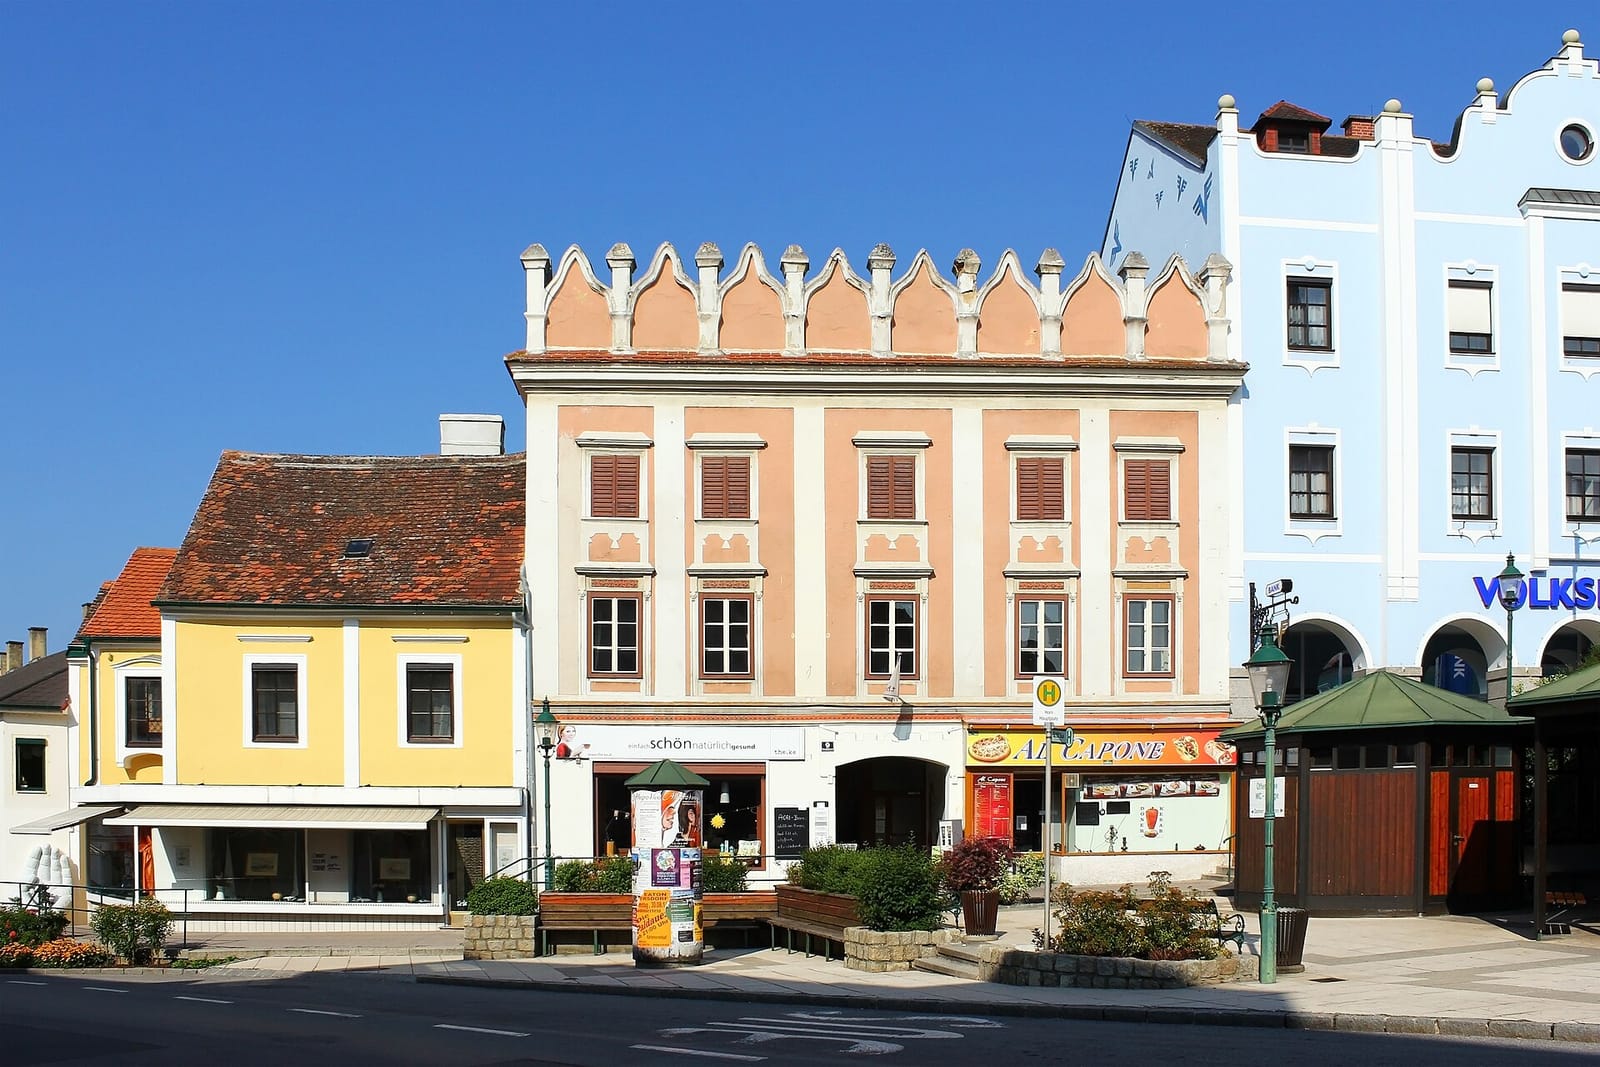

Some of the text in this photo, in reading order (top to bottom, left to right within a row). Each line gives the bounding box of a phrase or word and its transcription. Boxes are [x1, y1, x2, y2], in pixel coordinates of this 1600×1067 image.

[1472, 576, 1600, 611] VOLKS
[1043, 684, 1056, 702] H
[1062, 737, 1166, 760] CAPONE
